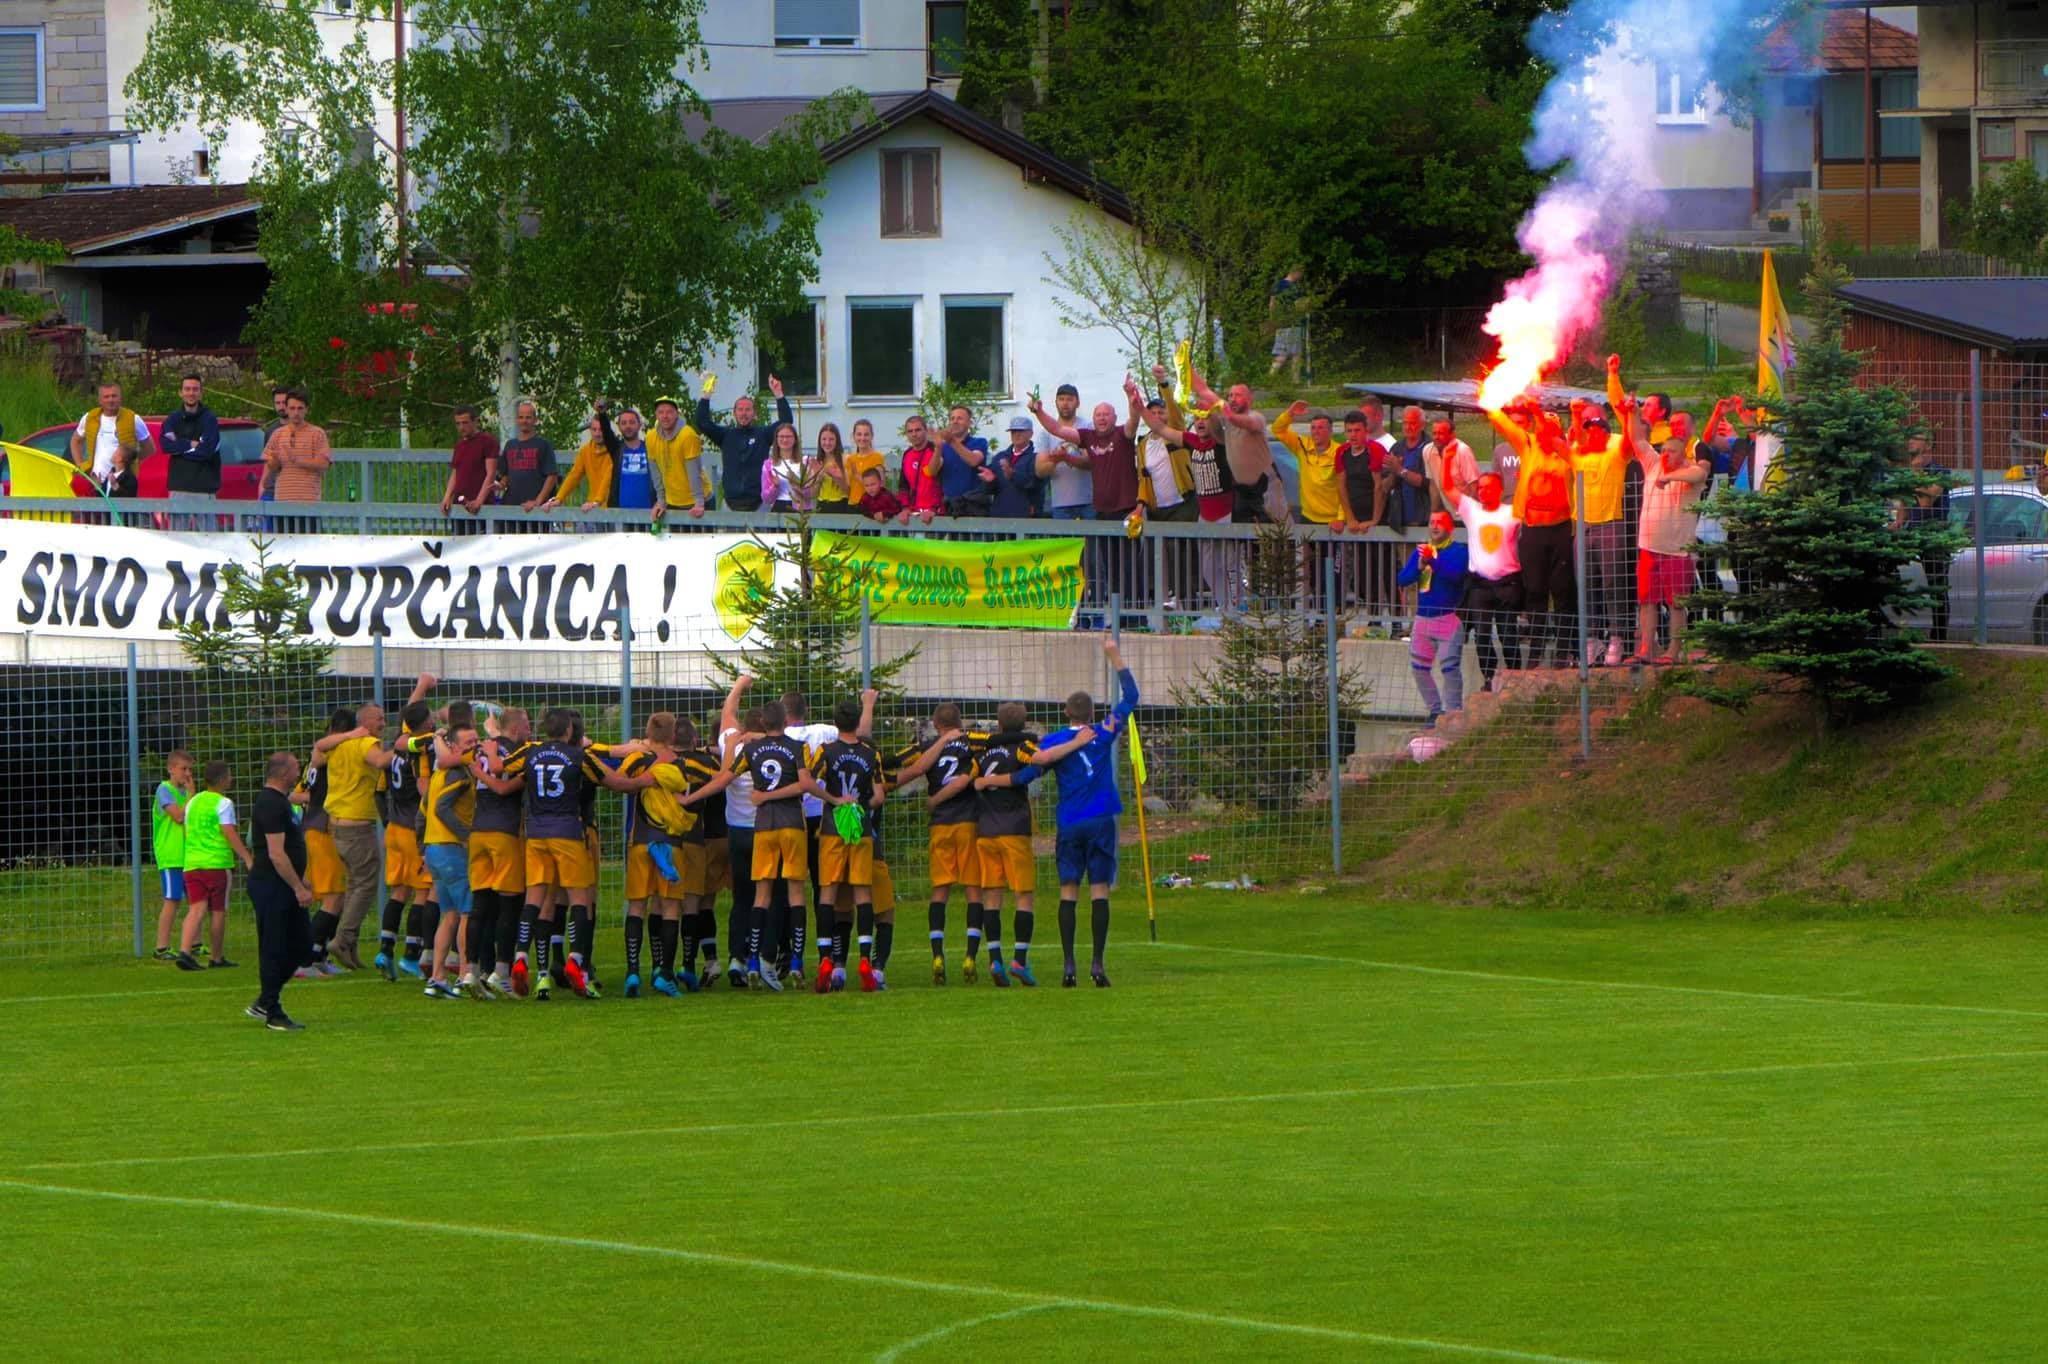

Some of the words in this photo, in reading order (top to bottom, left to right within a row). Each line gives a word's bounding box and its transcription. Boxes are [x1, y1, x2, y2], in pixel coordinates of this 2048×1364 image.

[17, 551, 148, 629] SMO
[657, 564, 677, 643] !
[534, 764, 565, 797] 13
[761, 758, 782, 790] 9
[938, 755, 959, 785] 2
